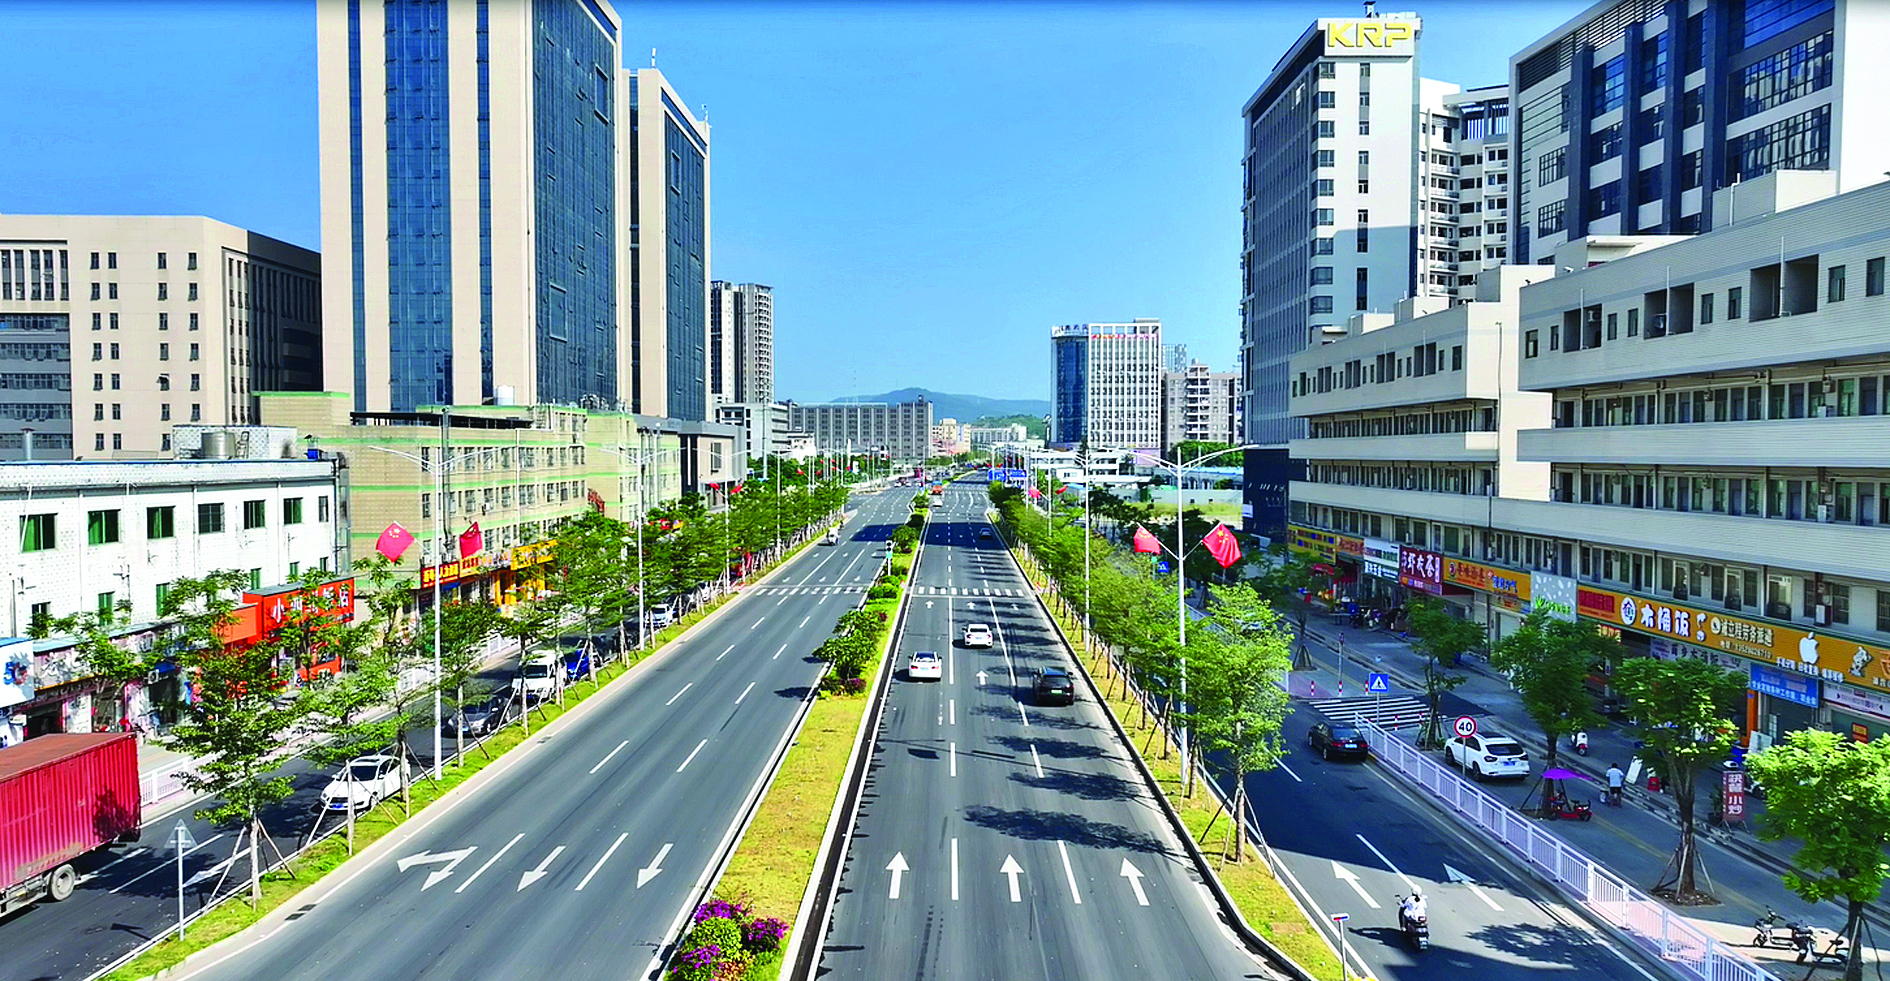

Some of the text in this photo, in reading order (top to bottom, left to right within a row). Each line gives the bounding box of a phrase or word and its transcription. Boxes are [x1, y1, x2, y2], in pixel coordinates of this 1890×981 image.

[1327, 22, 1412, 48] KRP
[1640, 604, 1690, 637] 木桶饭
[1458, 722, 1472, 731] 40
